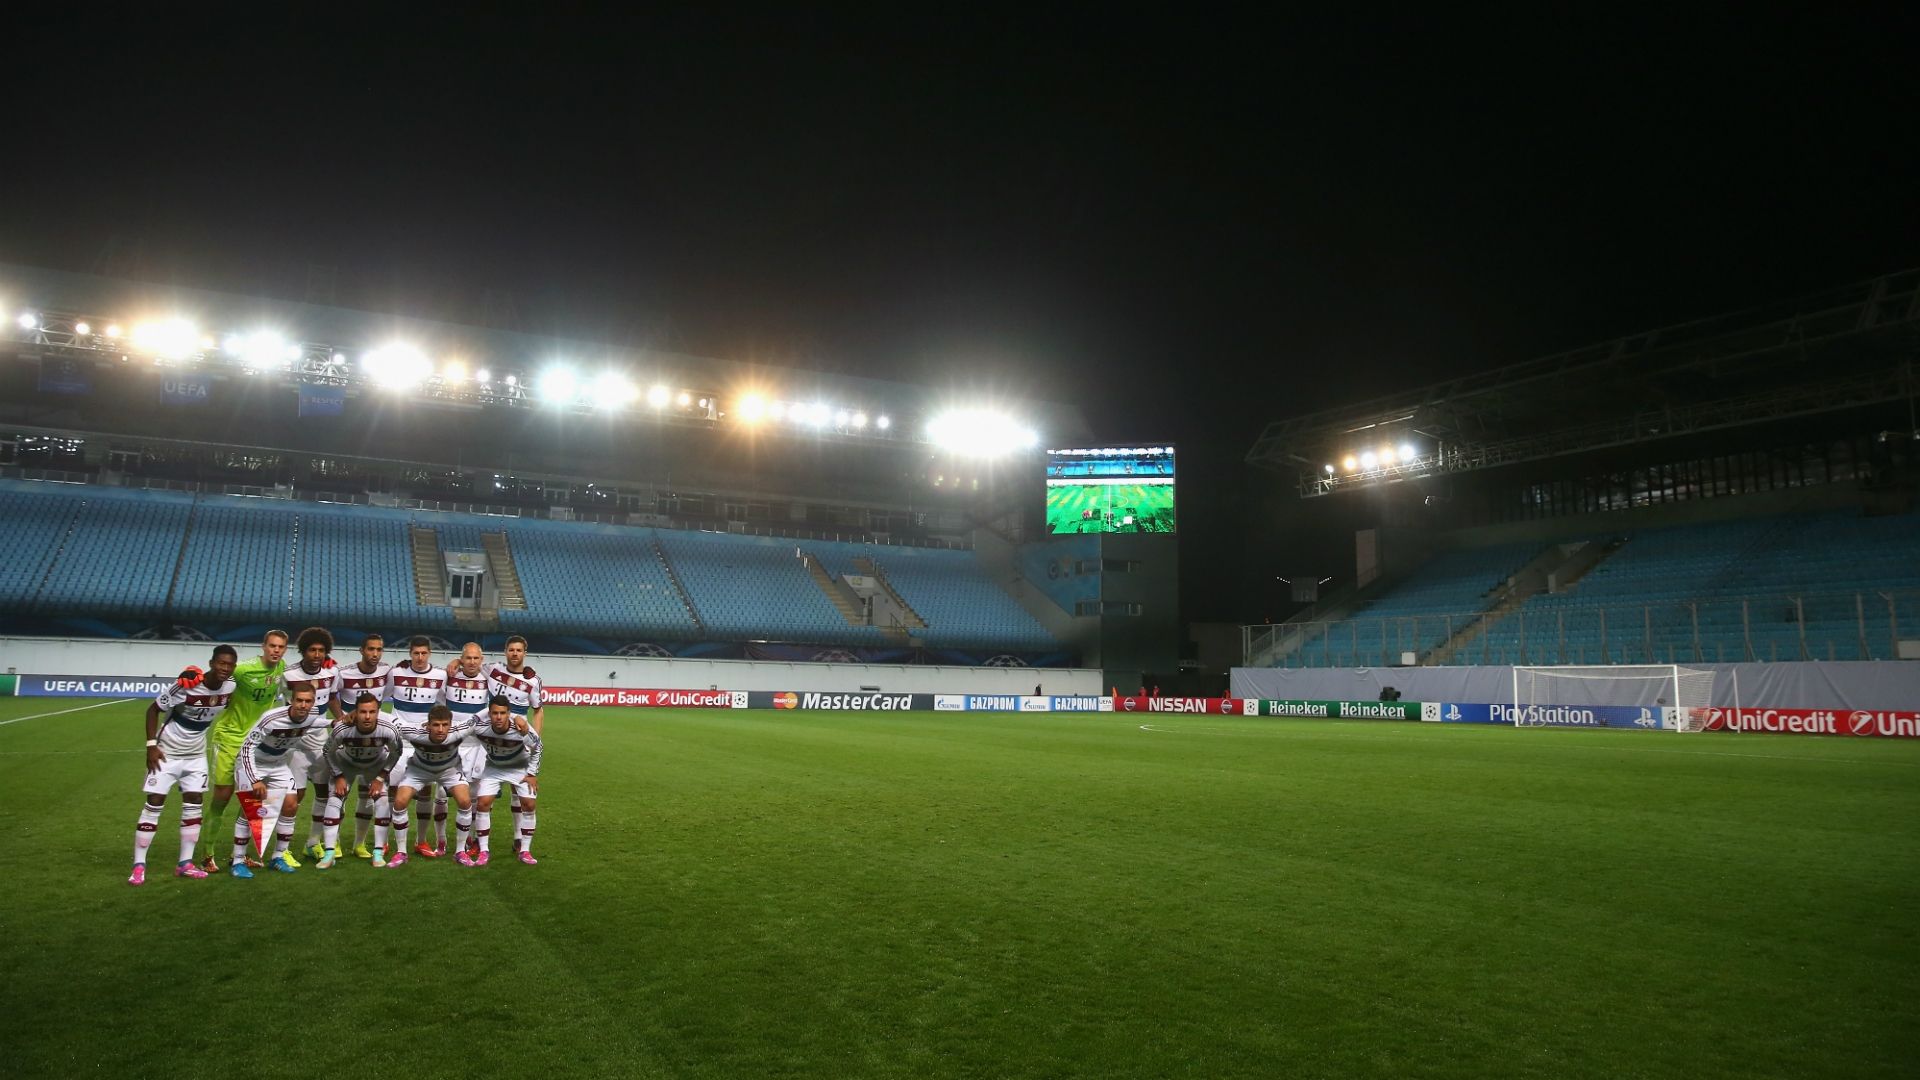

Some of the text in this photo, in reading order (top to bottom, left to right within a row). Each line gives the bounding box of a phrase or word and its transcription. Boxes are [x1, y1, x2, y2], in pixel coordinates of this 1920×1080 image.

[164, 382, 207, 397] UEFA
[44, 680, 86, 692] UEFA
[404, 688, 417, 701] T
[454, 688, 467, 701] T
[617, 691, 650, 705] Банк
[670, 692, 730, 707] UniCredit
[802, 692, 913, 710] MasterCard
[970, 696, 1015, 710] GAZPROM
[1055, 697, 1097, 710] GAZPROM
[1149, 697, 1207, 713] NISSAN
[1269, 700, 1328, 715] Heineken
[1340, 702, 1405, 718] Heineken
[1489, 704, 1593, 724] PlayStation
[1726, 709, 1836, 733] UniCredit
[1877, 712, 1920, 736] Uni
[201, 774, 208, 788] 2
[289, 777, 296, 791] 2
